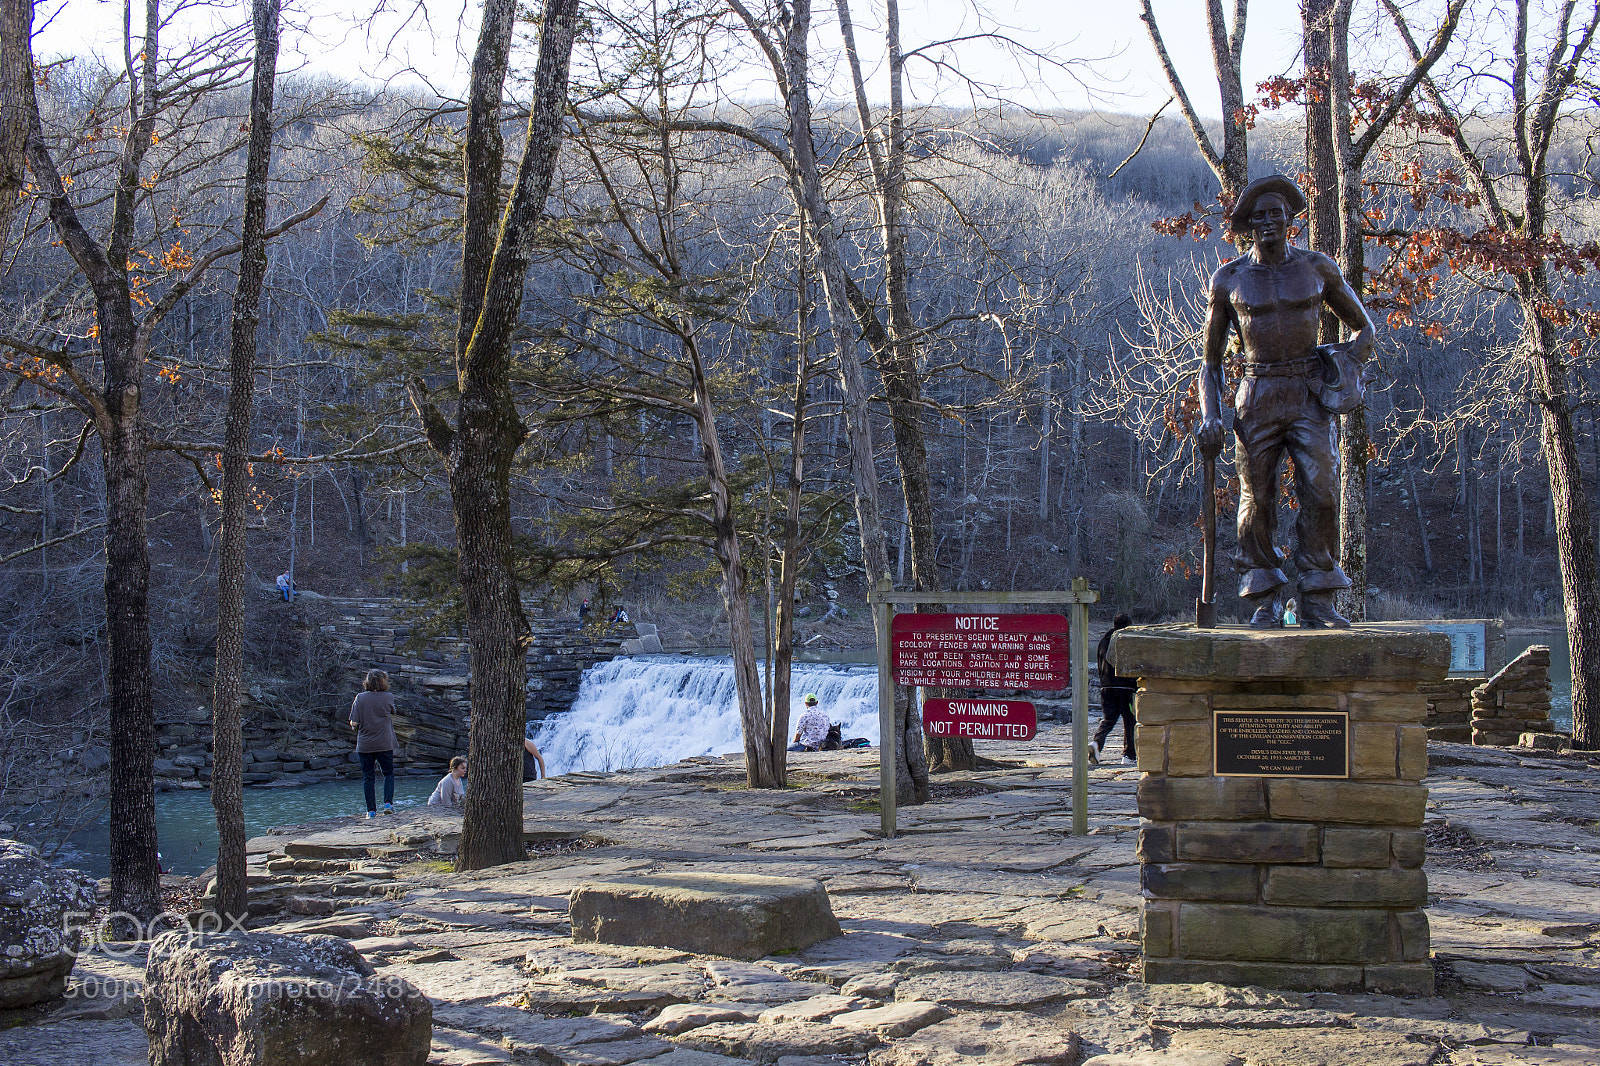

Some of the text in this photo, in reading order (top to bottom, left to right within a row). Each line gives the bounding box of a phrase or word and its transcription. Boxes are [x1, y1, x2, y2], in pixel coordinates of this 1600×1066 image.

[955, 616, 1000, 630] NOTICE
[900, 640, 932, 648] ECOLOGY
[948, 702, 1008, 716] SWIMMING
[930, 721, 1028, 738] NOT PERMITTED
